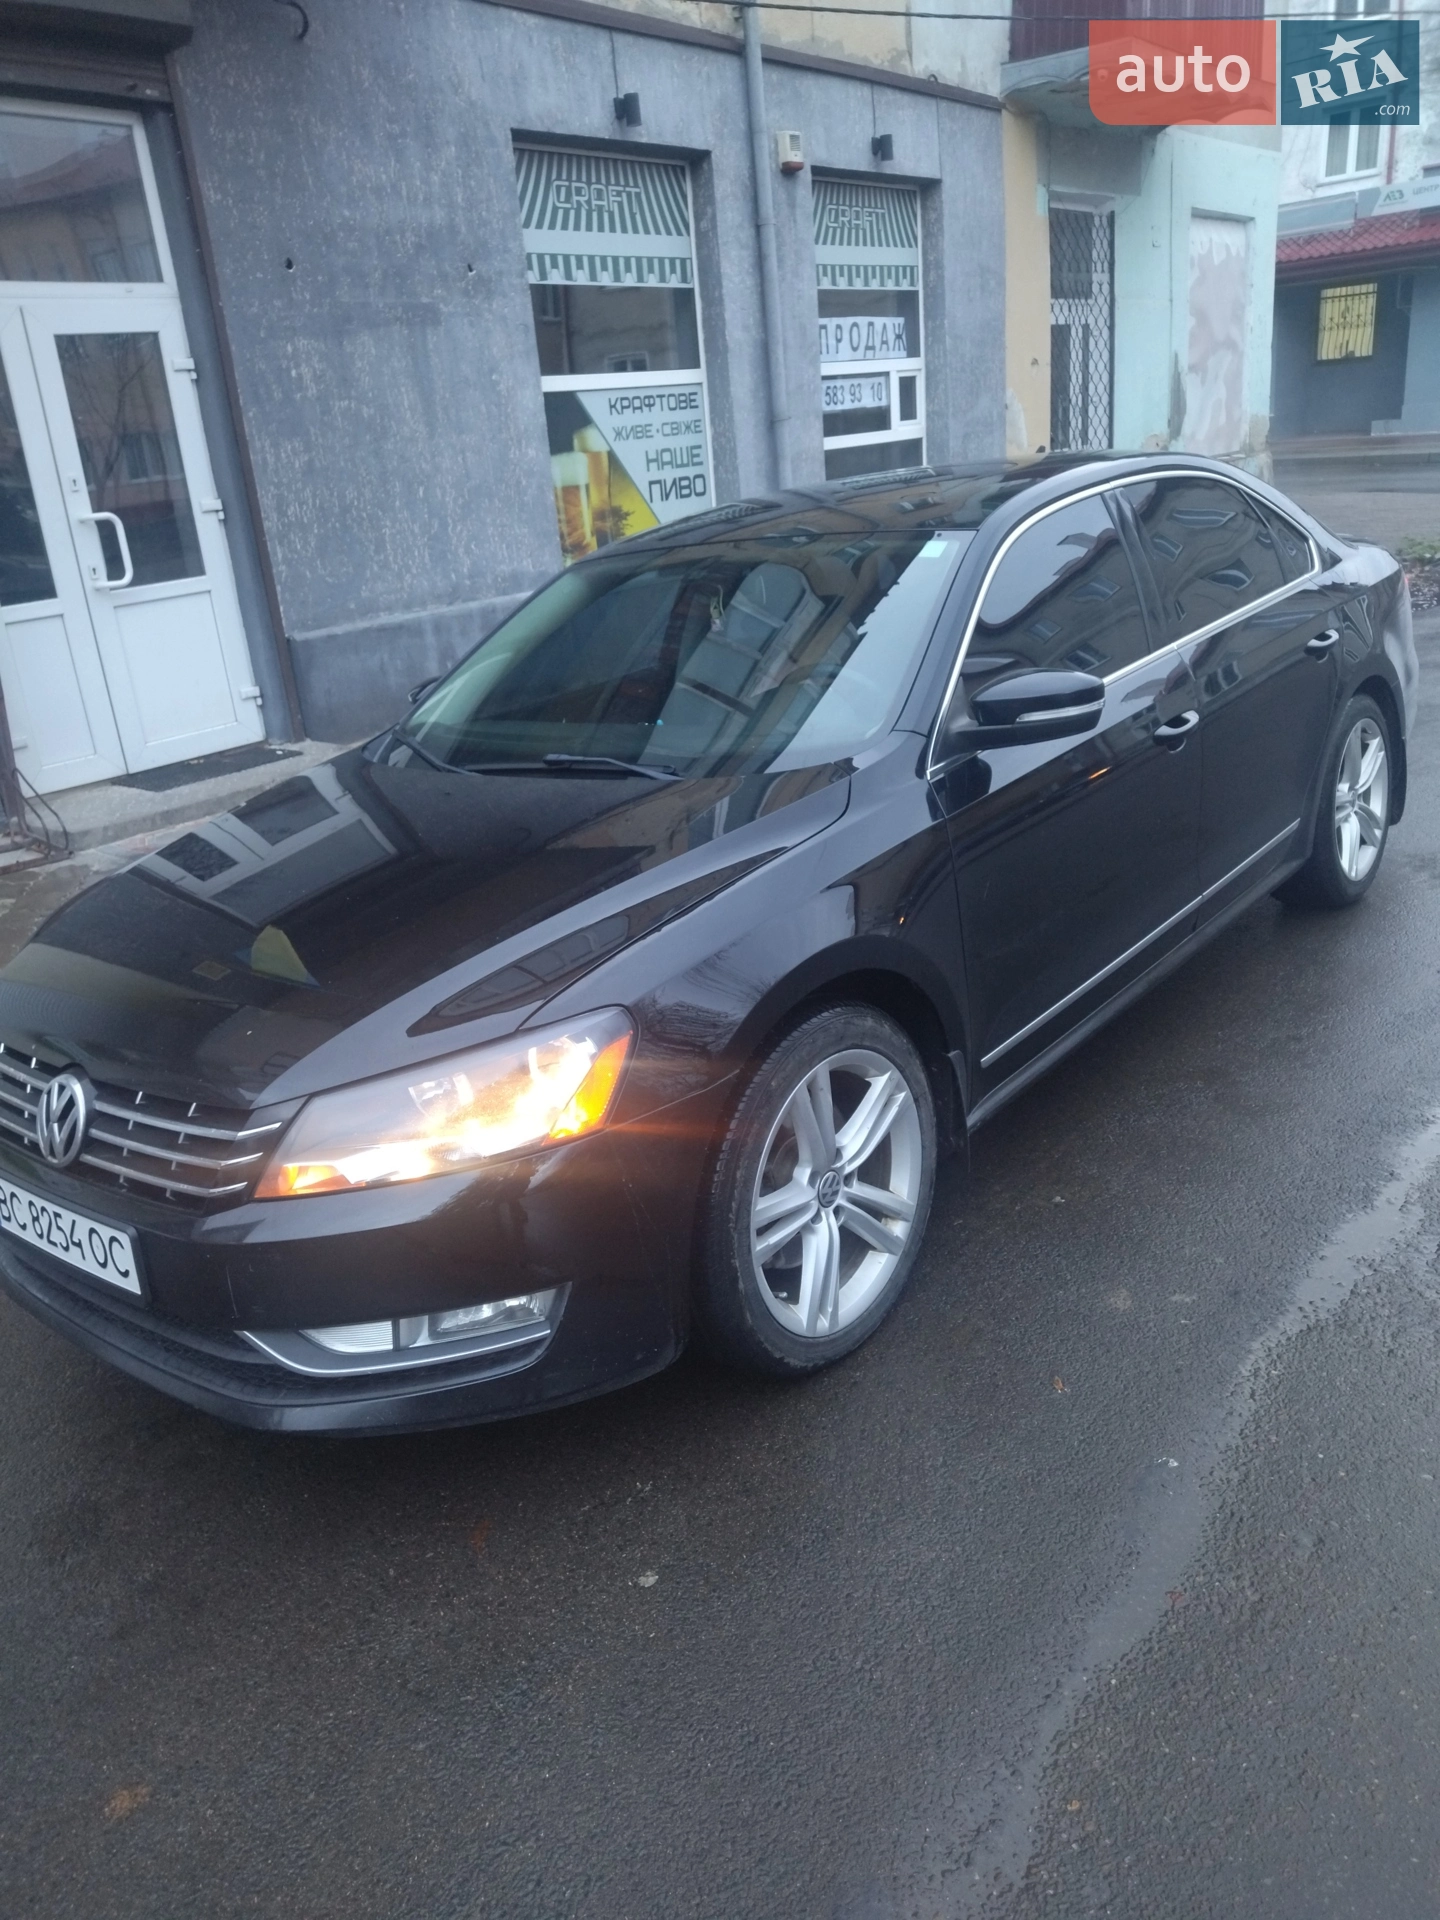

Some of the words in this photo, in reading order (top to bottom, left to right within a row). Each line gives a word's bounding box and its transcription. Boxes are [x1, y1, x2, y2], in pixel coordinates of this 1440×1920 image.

[552, 180, 641, 213] CRAFT
[826, 204, 886, 230] CRAFT
[819, 321, 906, 359] ПРОДАЖ
[608, 391, 699, 416] КРАФТОВЕ
[825, 384, 845, 406] 583
[849, 383, 863, 404] 93
[870, 381, 883, 402] 10
[612, 423, 654, 442] ЖИВЕ
[661, 419, 703, 437] СВІЖЕ
[645, 444, 704, 472] НАШЕ
[648, 473, 707, 504] ПИВО
[28, 1199, 86, 1261] 8254
[88, 1226, 130, 1279] OC
